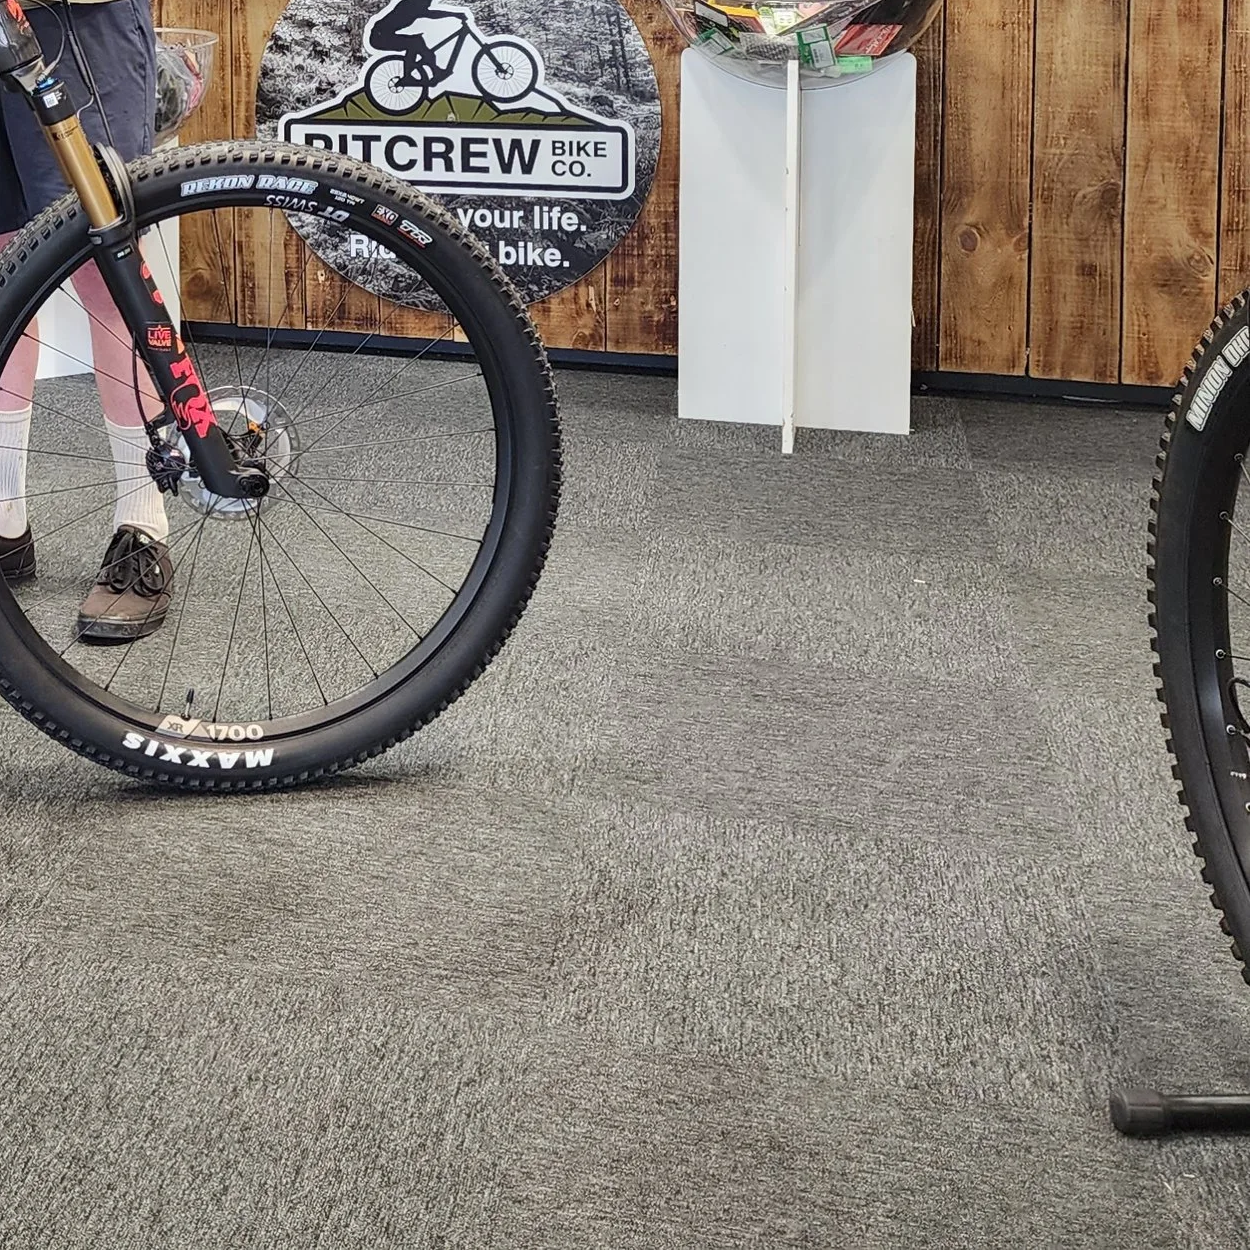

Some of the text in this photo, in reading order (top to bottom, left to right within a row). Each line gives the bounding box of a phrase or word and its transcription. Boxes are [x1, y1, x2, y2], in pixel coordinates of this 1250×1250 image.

[552, 141, 607, 158] BIKE
[551, 159, 592, 178] CO.
[181, 174, 318, 197] REKON RACE
[264, 194, 350, 223] DT SWISS
[374, 205, 397, 222] EXO
[457, 206, 587, 237] your life.
[499, 242, 570, 268] bike.
[147, 330, 172, 339] LIVE
[148, 338, 172, 347] VALVE
[170, 353, 219, 439] FOX
[1185, 355, 1233, 432] MINION
[167, 720, 184, 733] XR
[207, 724, 264, 742] 1700
[122, 732, 275, 769] MAXXIS
